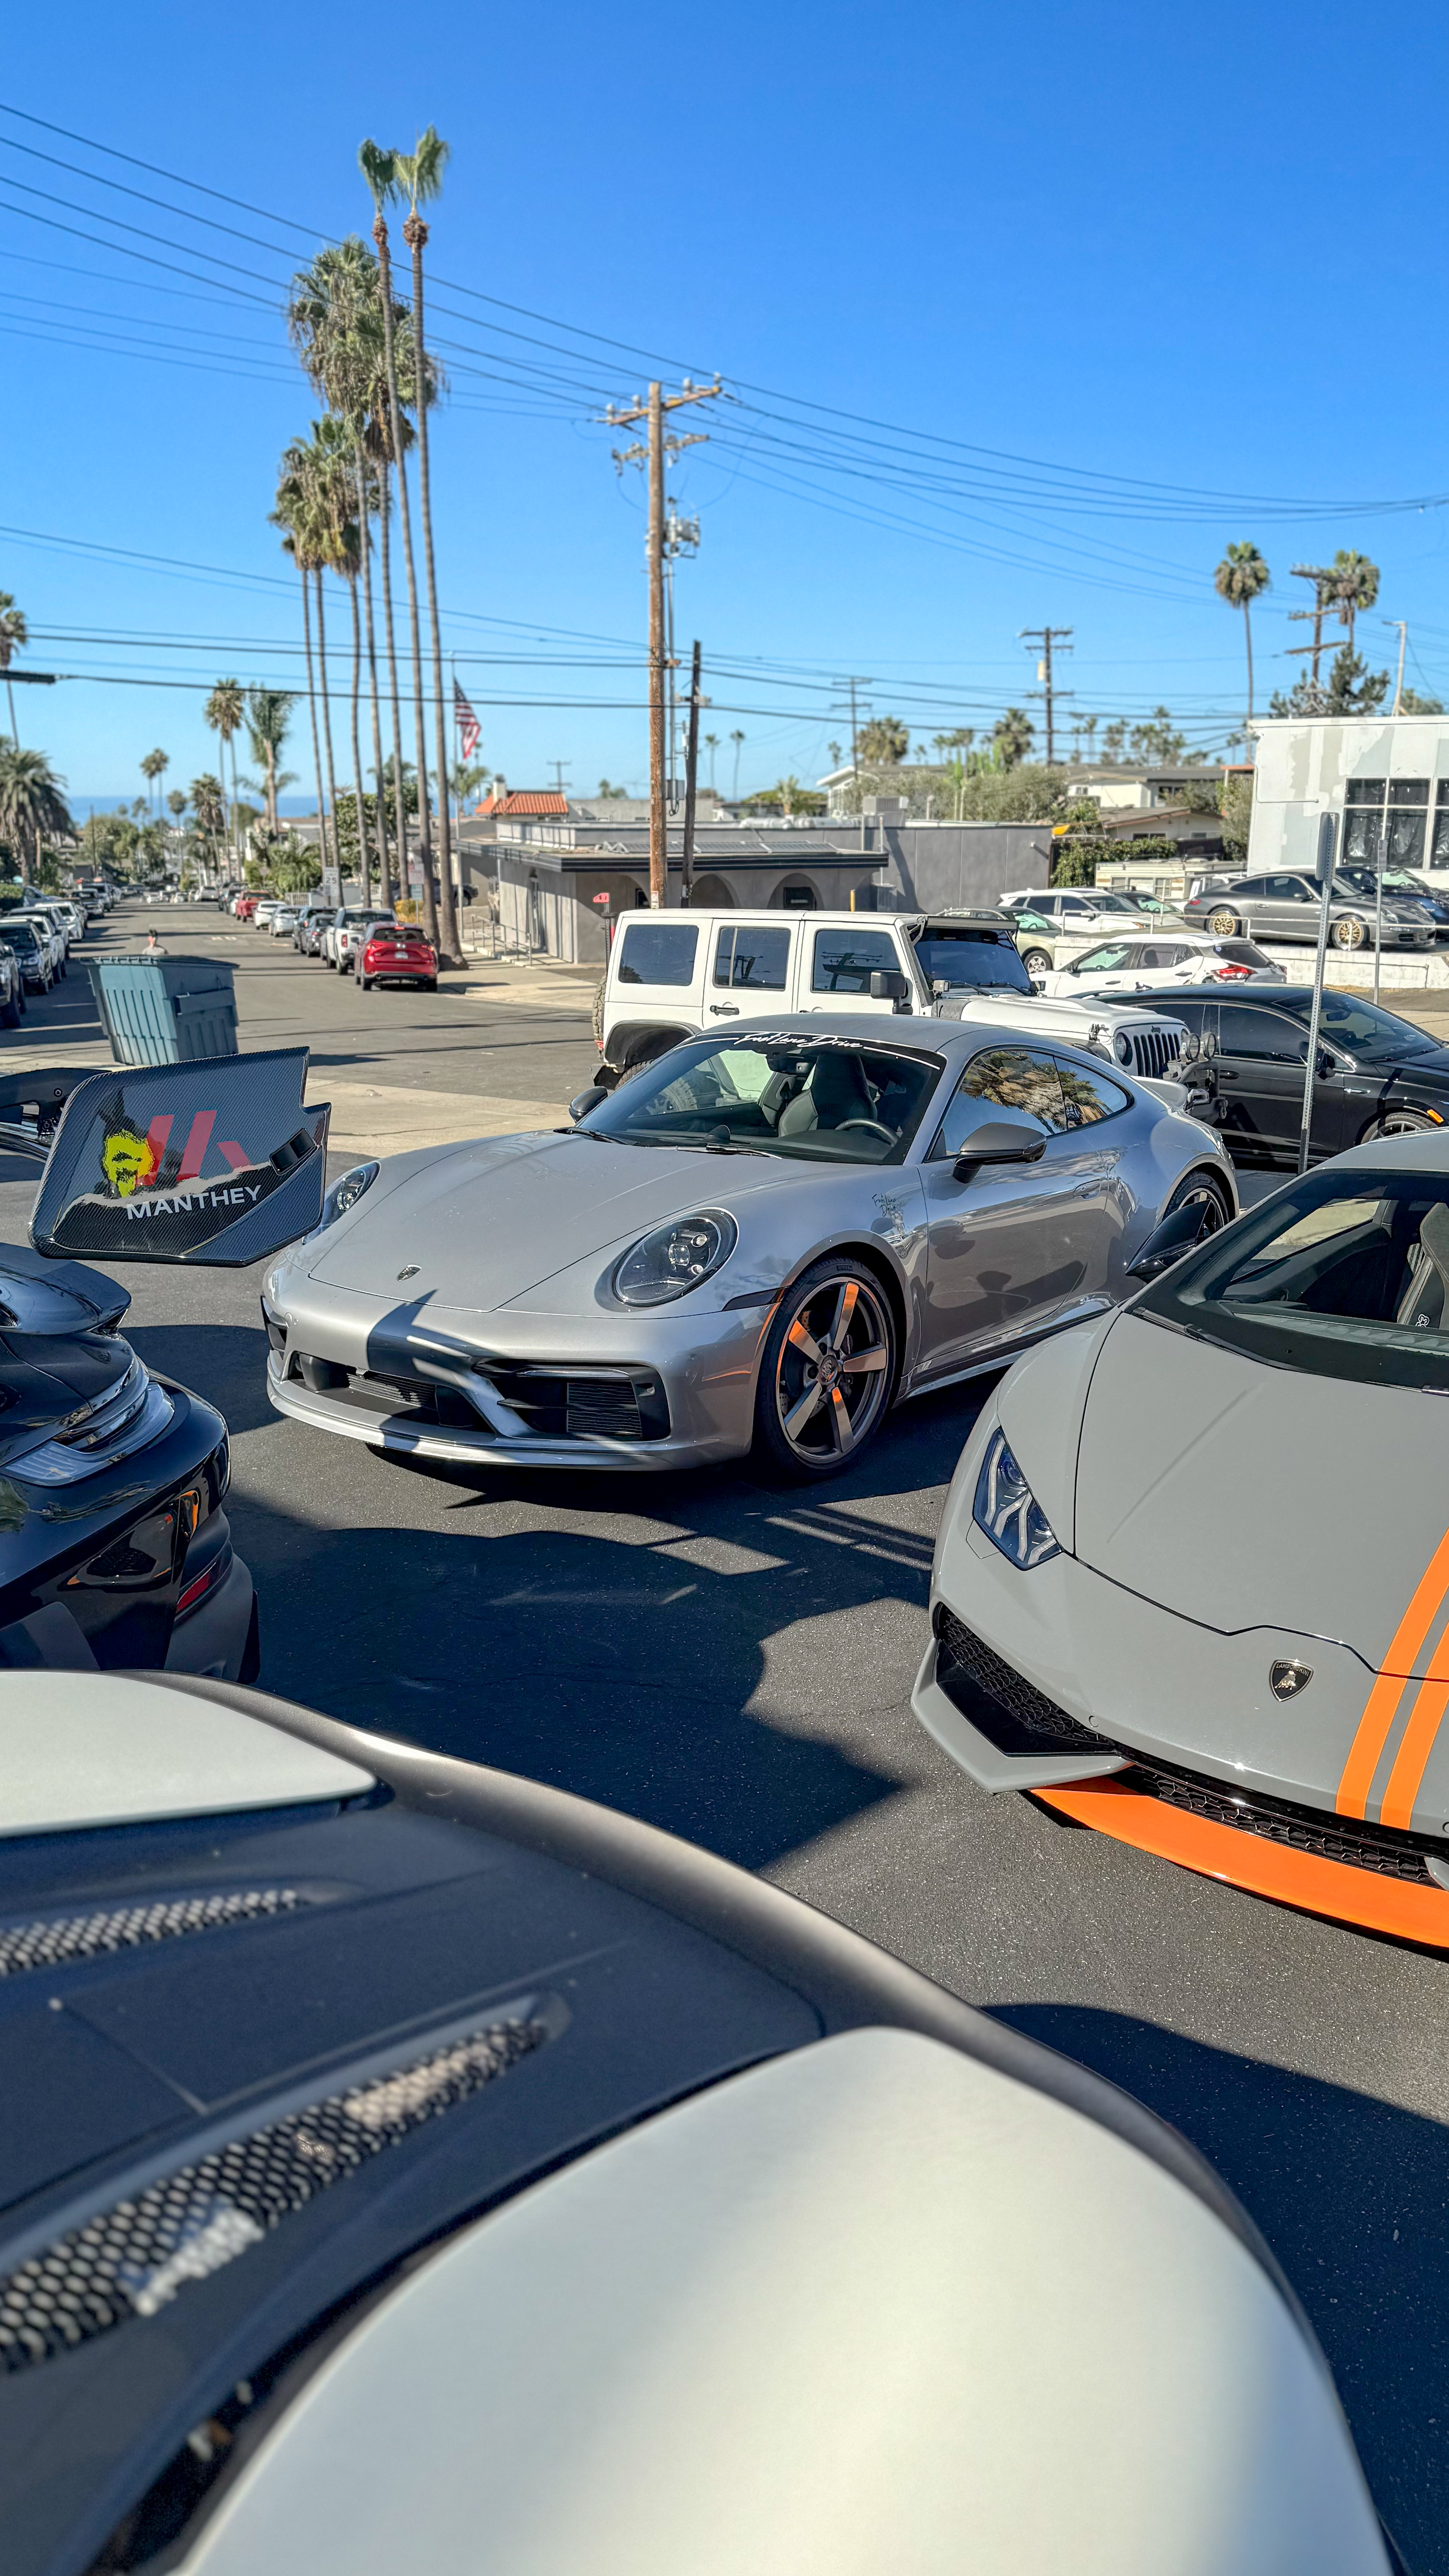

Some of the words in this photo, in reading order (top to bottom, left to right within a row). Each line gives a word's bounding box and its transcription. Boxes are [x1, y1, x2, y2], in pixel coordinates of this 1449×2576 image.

[797, 1036, 863, 1048] Drive
[126, 1185, 262, 1220] MANTHEY
[1276, 1663, 1311, 1676] LAMBORGHINI
